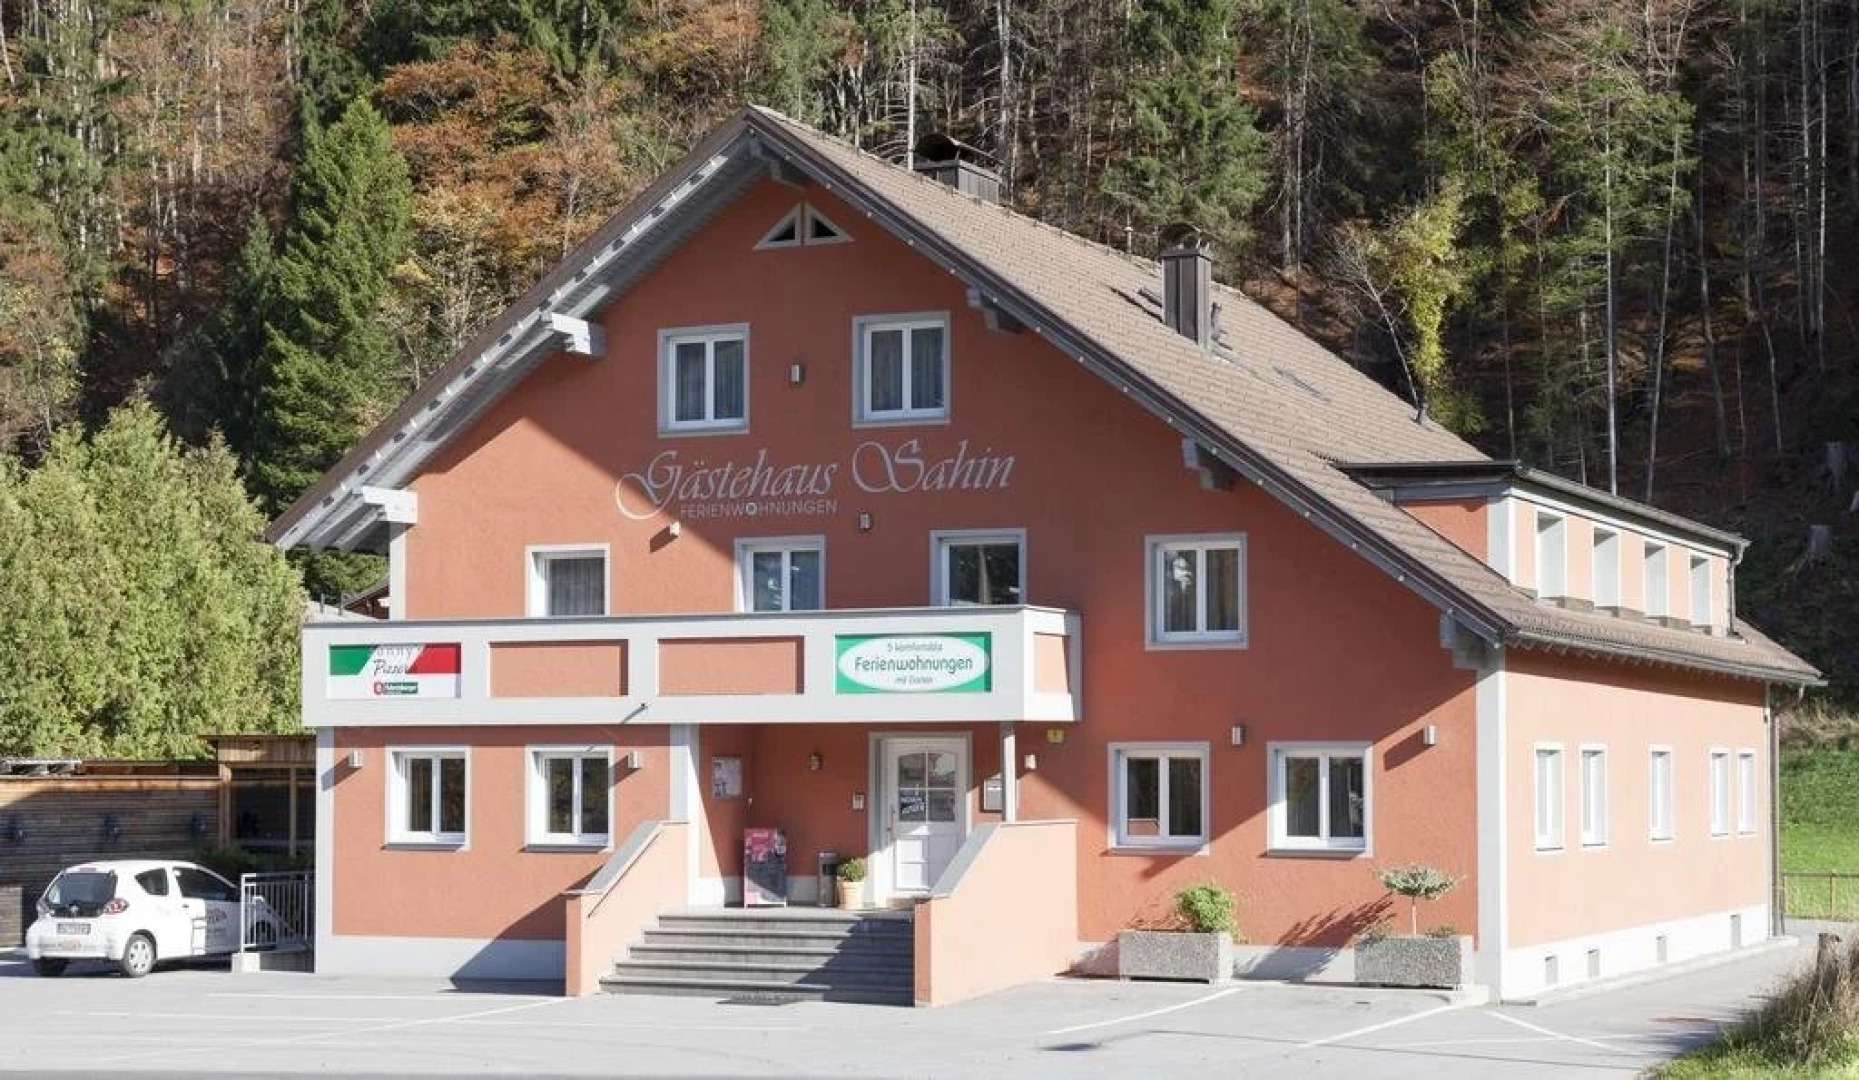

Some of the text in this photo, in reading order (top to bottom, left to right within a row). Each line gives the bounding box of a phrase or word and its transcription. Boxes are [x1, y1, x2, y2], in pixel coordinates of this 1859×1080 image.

[615, 438, 1016, 520] Gästehaus Sahin
[680, 500, 838, 519] FERIENWOHNUNGEN
[854, 655, 974, 674] Ferienwohnungen
